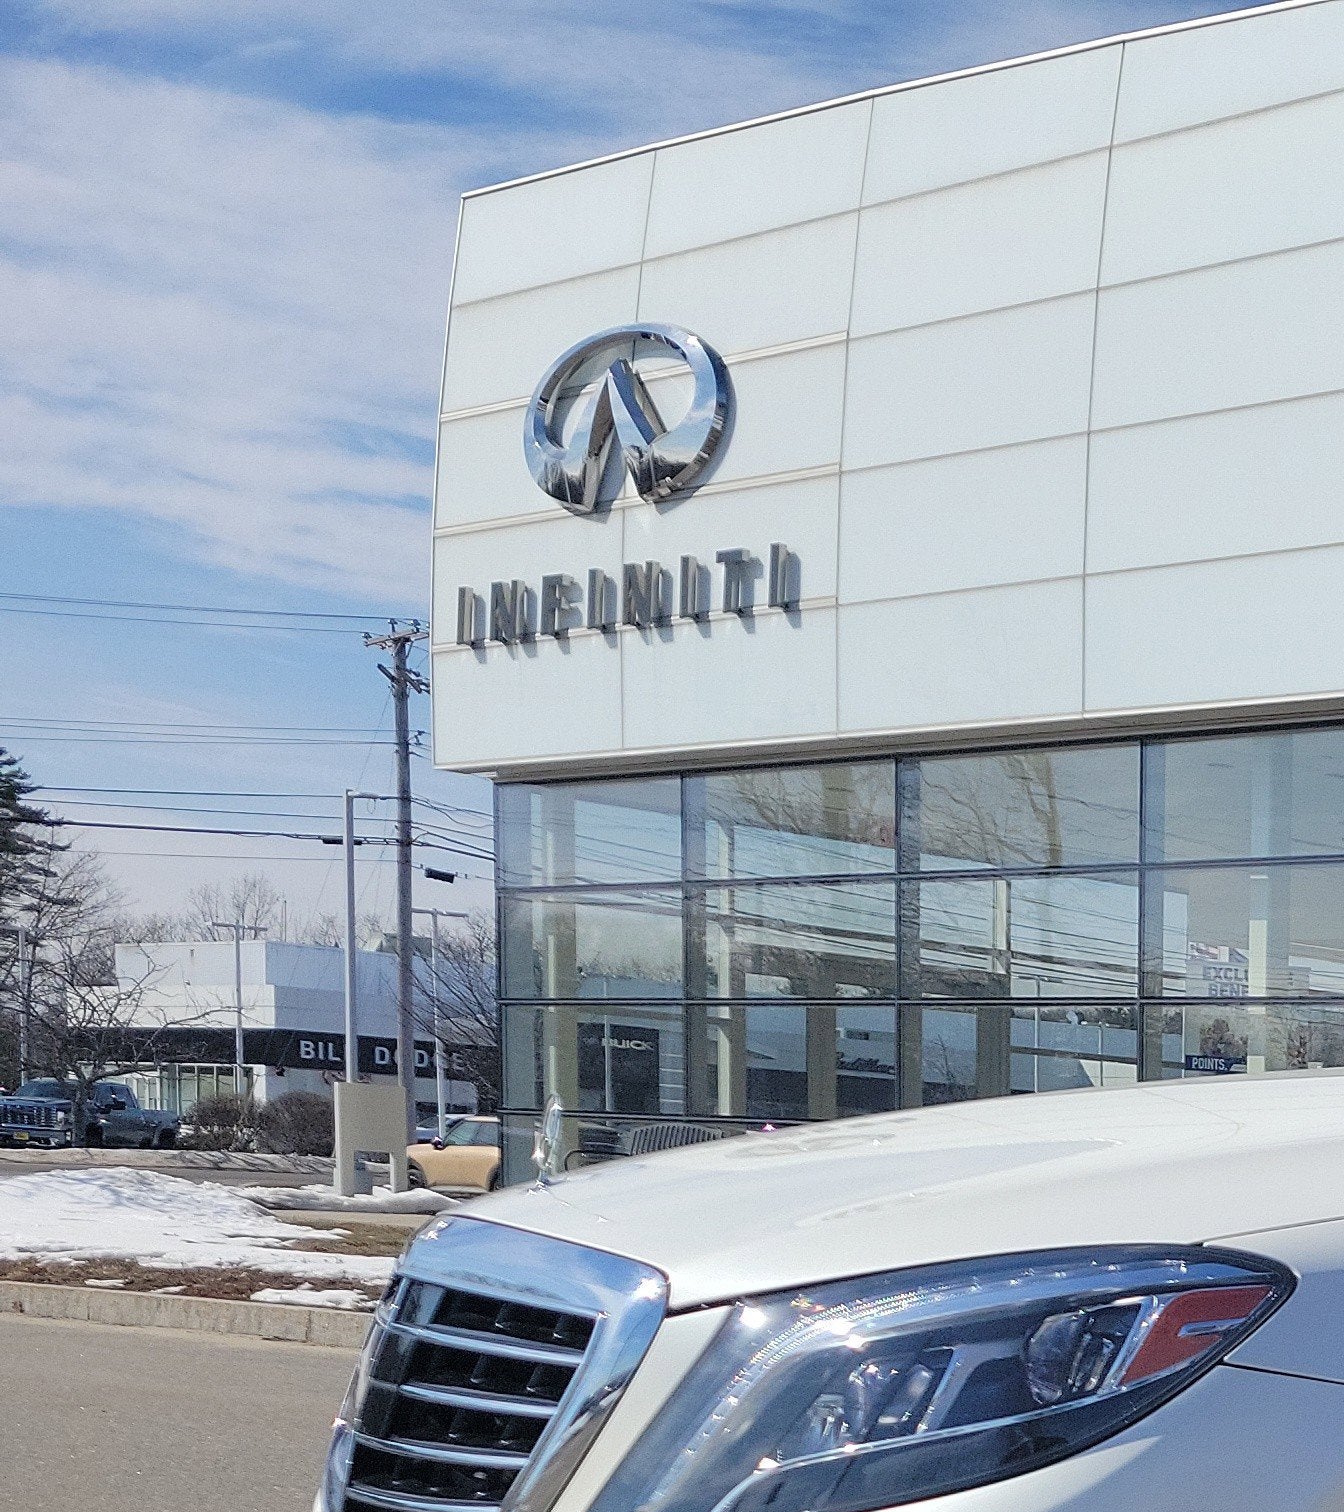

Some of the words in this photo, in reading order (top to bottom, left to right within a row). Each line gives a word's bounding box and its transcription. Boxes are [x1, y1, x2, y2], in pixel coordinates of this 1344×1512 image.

[457, 542, 788, 646] INFINITI
[300, 1040, 342, 1062] BIL
[1191, 1057, 1228, 1071] POINTS.
